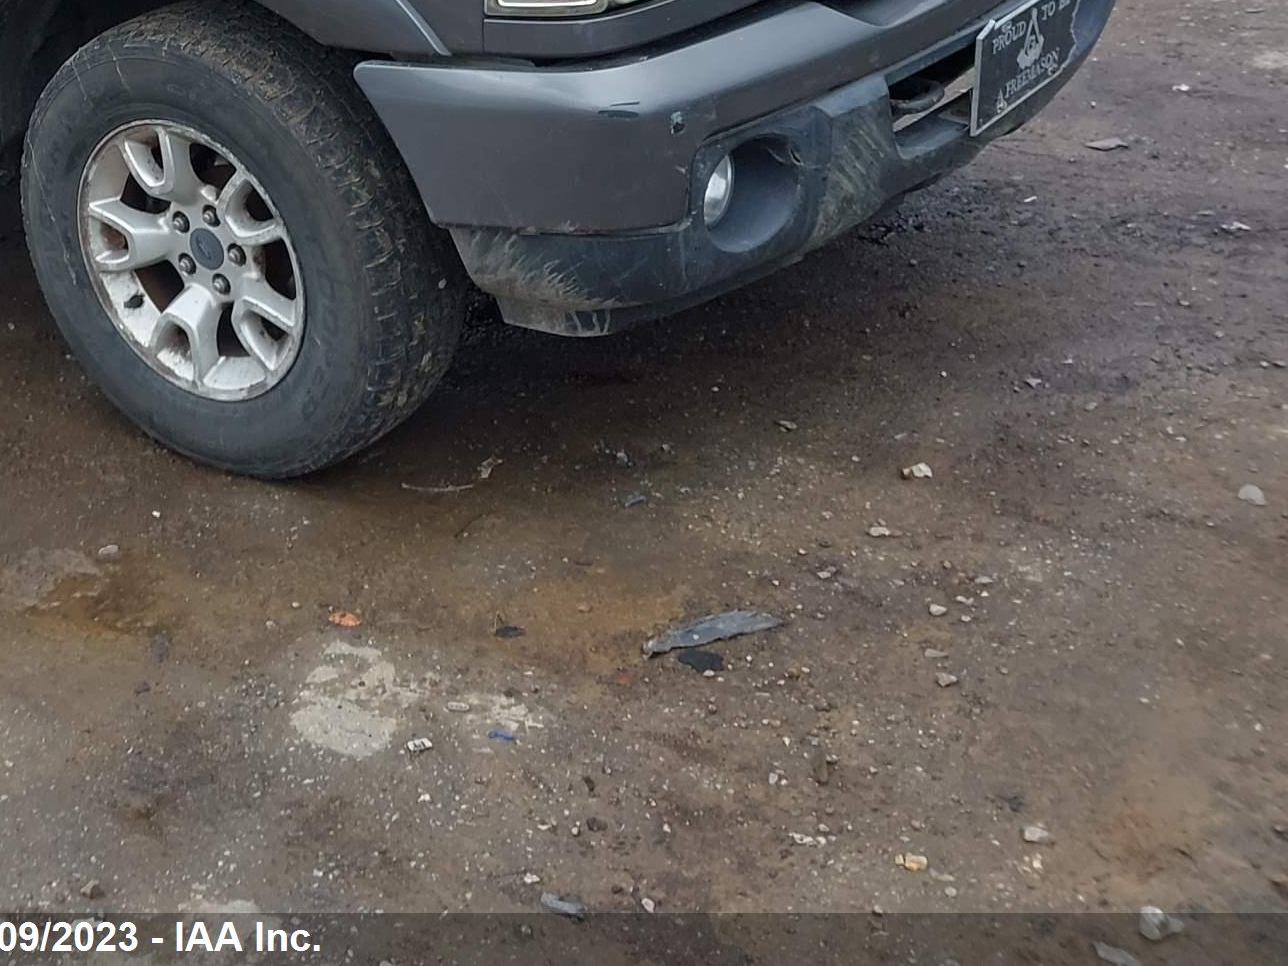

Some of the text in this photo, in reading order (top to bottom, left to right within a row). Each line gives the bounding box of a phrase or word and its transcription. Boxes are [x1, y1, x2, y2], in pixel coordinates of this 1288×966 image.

[992, 21, 1026, 54] PROUD
[1041, 1, 1056, 21] TO
[1004, 47, 1060, 99] FREEMASON
